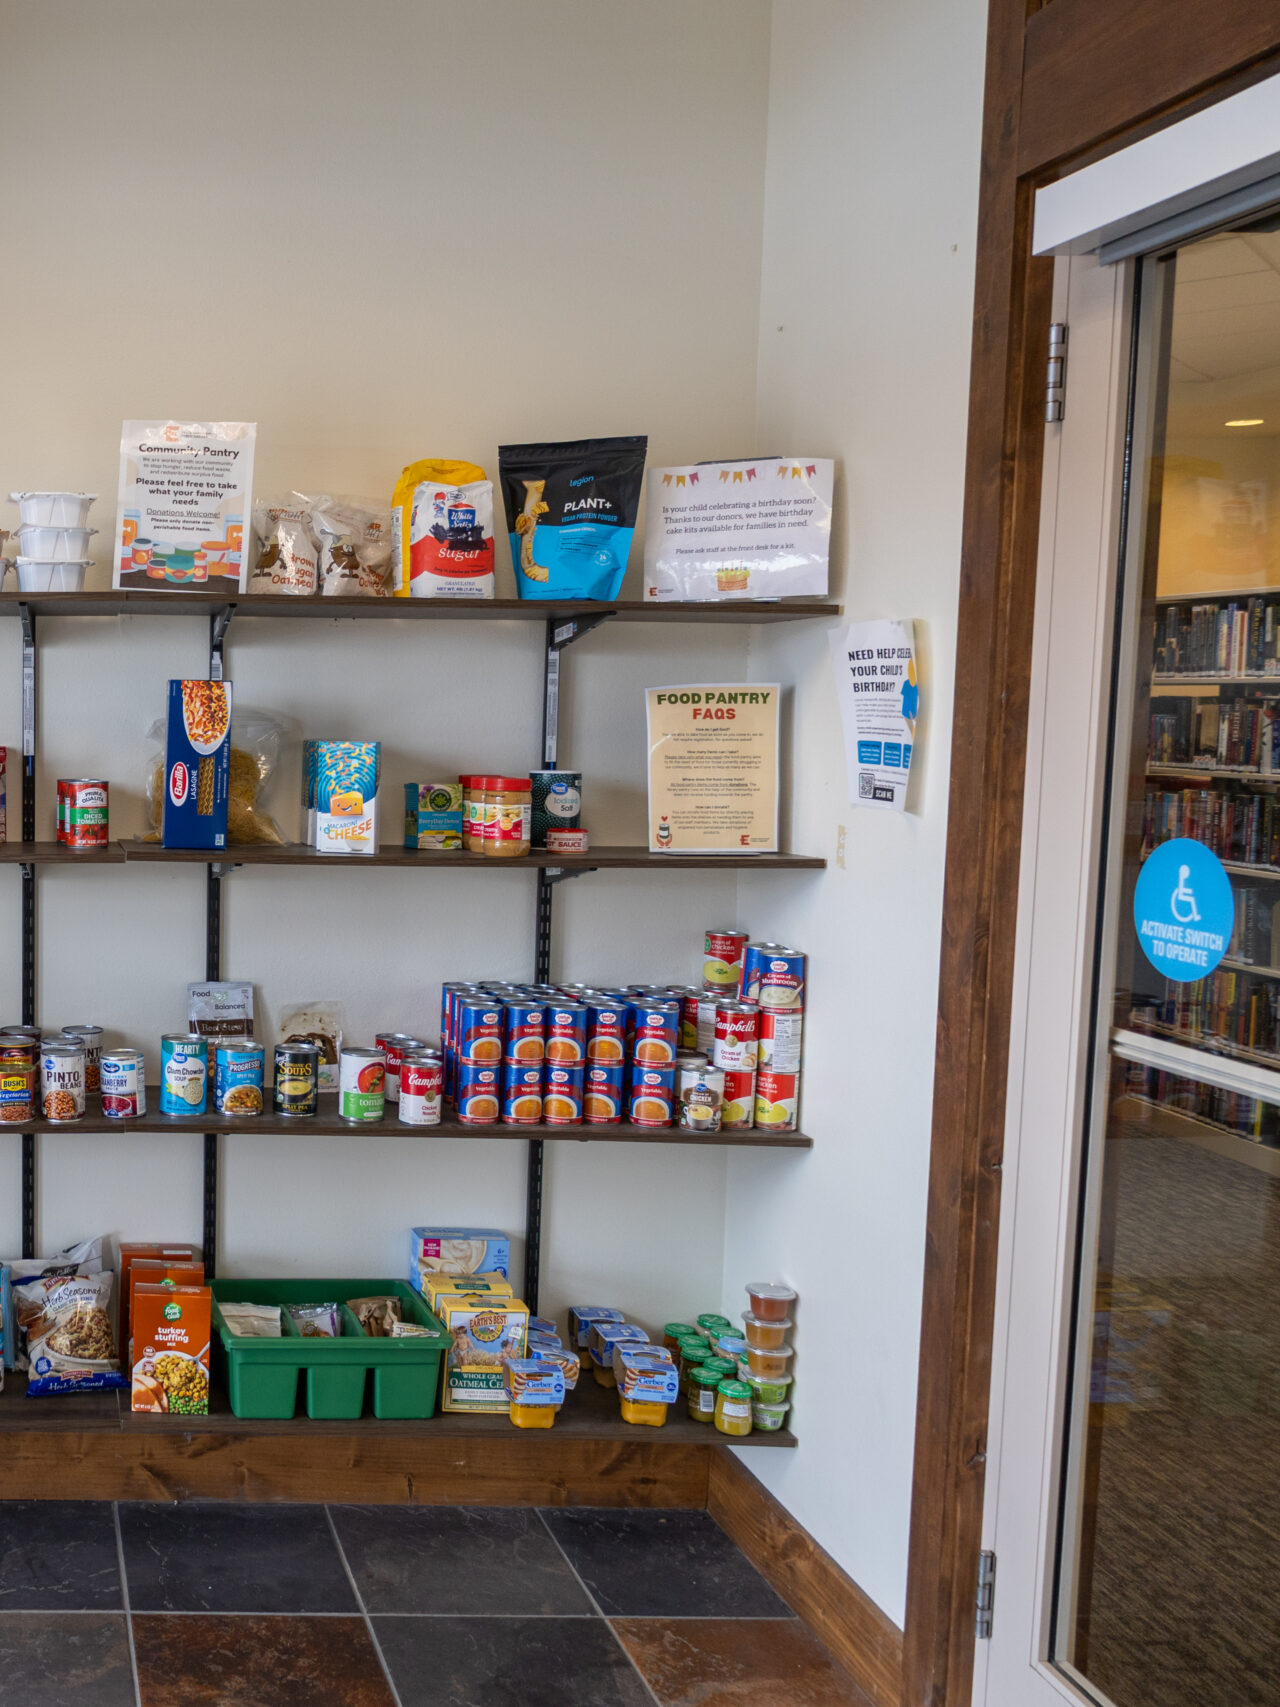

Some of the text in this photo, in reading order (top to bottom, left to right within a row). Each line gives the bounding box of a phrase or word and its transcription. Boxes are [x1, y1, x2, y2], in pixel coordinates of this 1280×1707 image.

[139, 443, 239, 459] Community Pantry
[136, 478, 165, 486] Please
[168, 479, 183, 487] feel
[186, 480, 203, 488] free
[570, 475, 594, 487] legion
[196, 490, 223, 499] family
[563, 498, 612, 513] PLANT+
[662, 506, 669, 514] Is
[670, 505, 688, 514] your
[709, 501, 750, 511] celebrating
[758, 498, 791, 507] birthday
[146, 508, 220, 519] Donations Welcome!
[450, 512, 473, 521] White
[576, 513, 618, 522] PROTEIN POWDER
[664, 516, 691, 524] Thanks
[716, 513, 744, 521] donors,
[758, 510, 777, 518] have
[779, 508, 813, 518] birthday
[684, 526, 698, 534] kits
[699, 524, 732, 533] available
[733, 523, 744, 531] for
[746, 521, 776, 530] families
[787, 520, 808, 528] need.
[438, 546, 480, 561] sugar
[848, 648, 895, 661] NEED HELP
[850, 665, 903, 677] YOUR CHILD'S
[853, 682, 895, 692] BIRTHDAY?
[657, 693, 770, 705] FOOD PANTRY
[692, 708, 736, 720] FAQS
[174, 765, 184, 797] Barilla
[875, 789, 885, 799] SCAN
[560, 804, 573, 812] Salt
[327, 821, 358, 829] MACARONI
[327, 818, 372, 841] CHEESE
[1141, 920, 1223, 951] ACTIVATE SWITCH
[1152, 940, 1208, 967] TO OPERATE
[175, 1045, 200, 1054] HEARTY
[167, 1066, 182, 1074] Clam
[230, 1061, 260, 1072] PROGRESSO
[280, 1063, 312, 1075] SOUPS
[47, 1071, 79, 1082] PINTO
[61, 1081, 81, 1089] BEANS
[42, 1285, 102, 1307] Herb Seasoned
[469, 1315, 507, 1328] EARTH'S BEST
[158, 1327, 186, 1336] turkey
[155, 1334, 189, 1343] stuffing
[48, 1382, 67, 1390] Herb
[450, 1378, 488, 1388] OATMEAL
[527, 1381, 552, 1389] Gerber
[639, 1377, 664, 1386] Gerber
